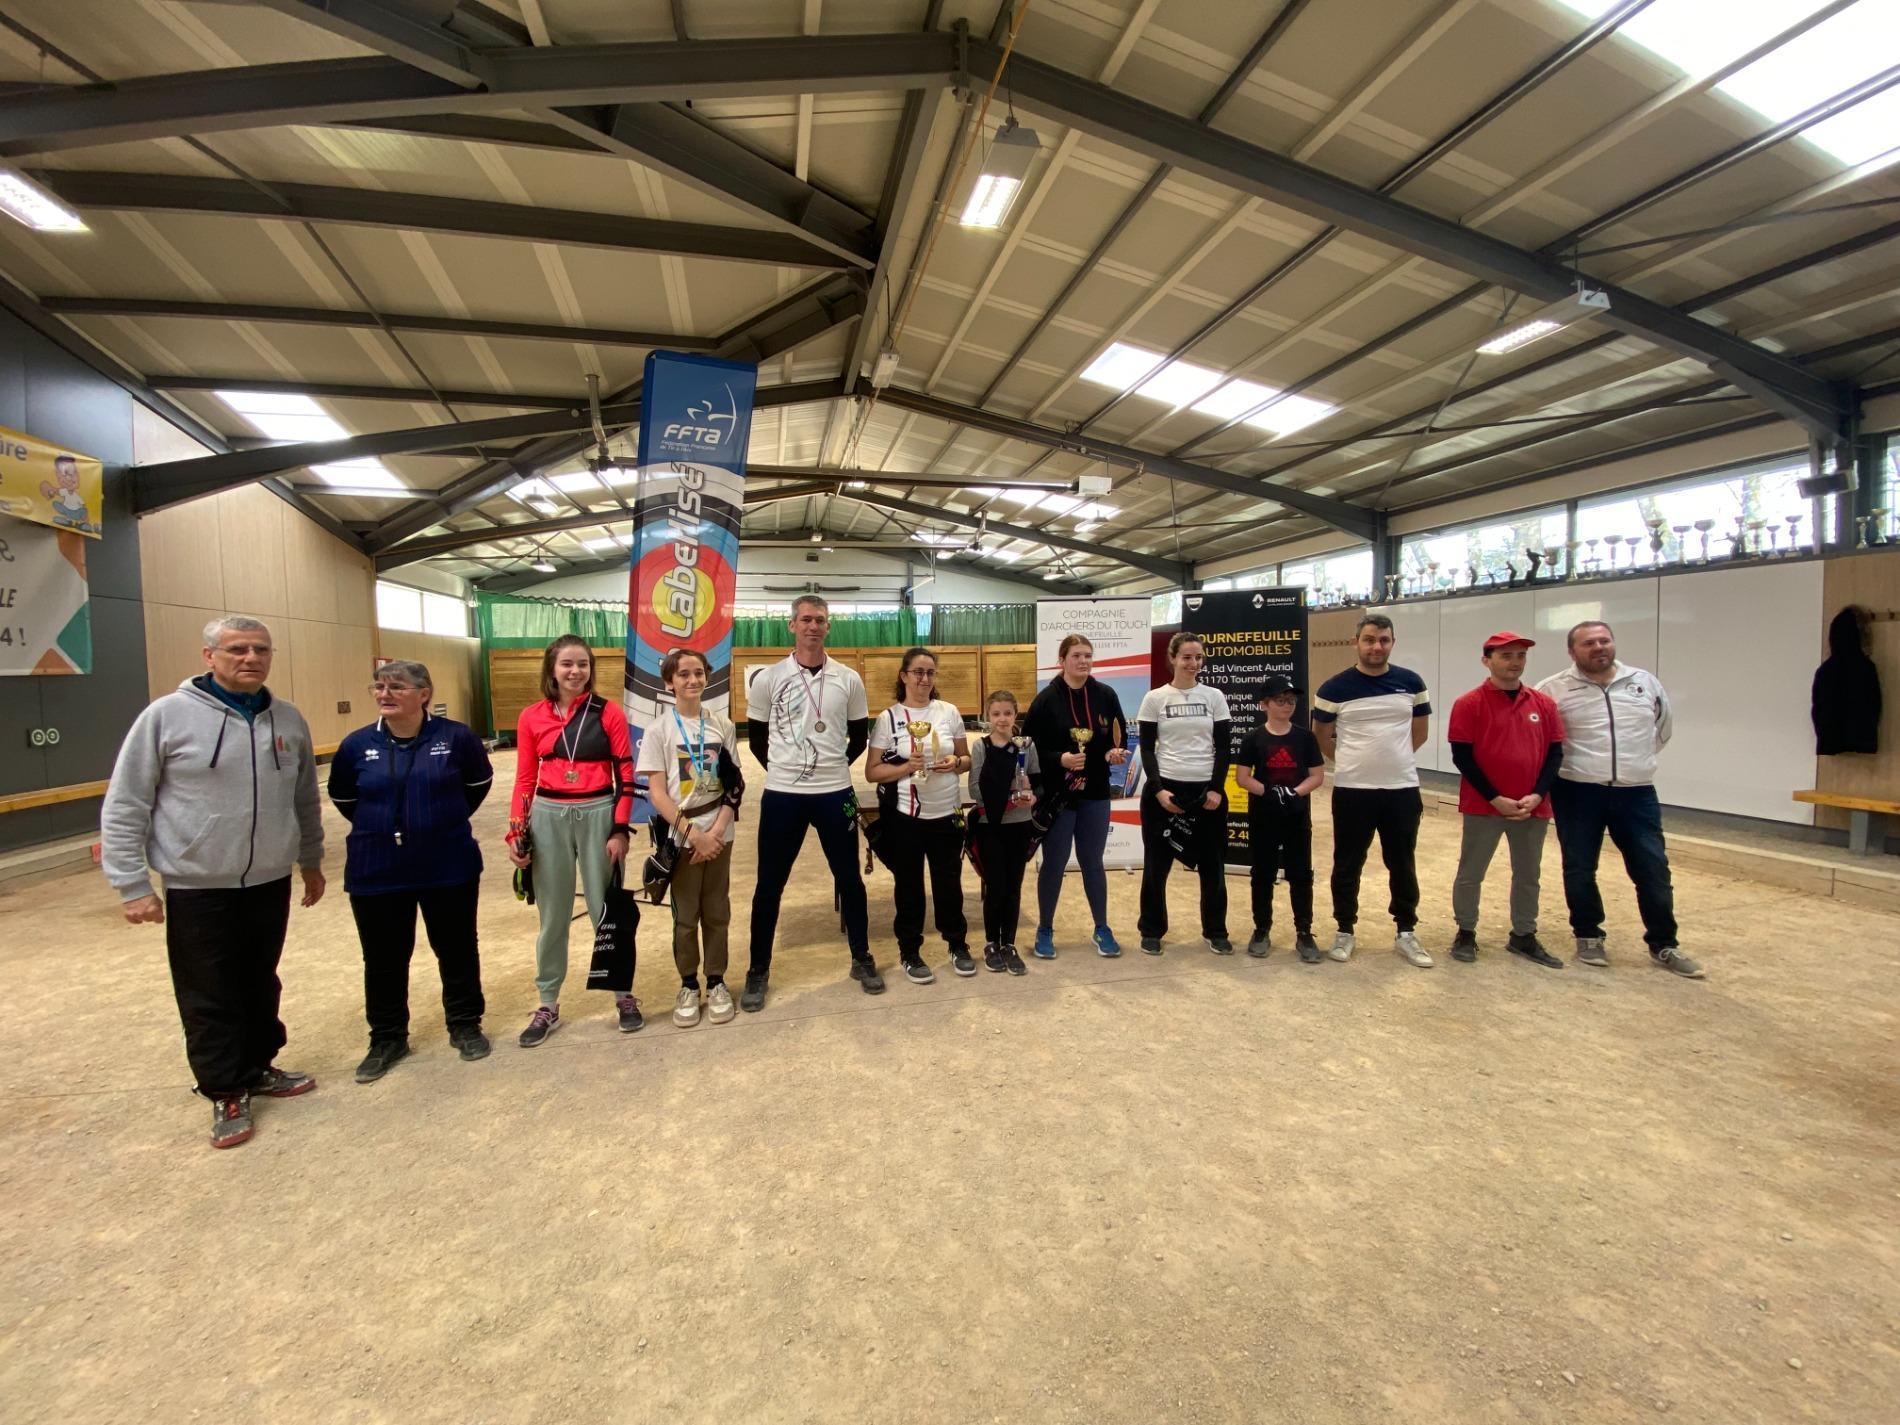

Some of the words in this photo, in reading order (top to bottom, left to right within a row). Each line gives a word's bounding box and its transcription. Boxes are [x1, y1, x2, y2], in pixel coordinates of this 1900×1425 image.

[0, 588, 17, 608] LE
[1063, 609, 1126, 619] COMPAGNIE
[1041, 621, 1095, 631] D'ARCHERS
[1097, 621, 1112, 630] DU
[1115, 620, 1148, 630] TOUCH
[1197, 629, 1301, 644] OURNEFEUILLE
[1212, 664, 1224, 673] Bd
[1227, 663, 1262, 672] Vincent
[1265, 662, 1294, 671] Auriol
[1198, 675, 1228, 684] 31170
[1228, 715, 1255, 723] sserie
